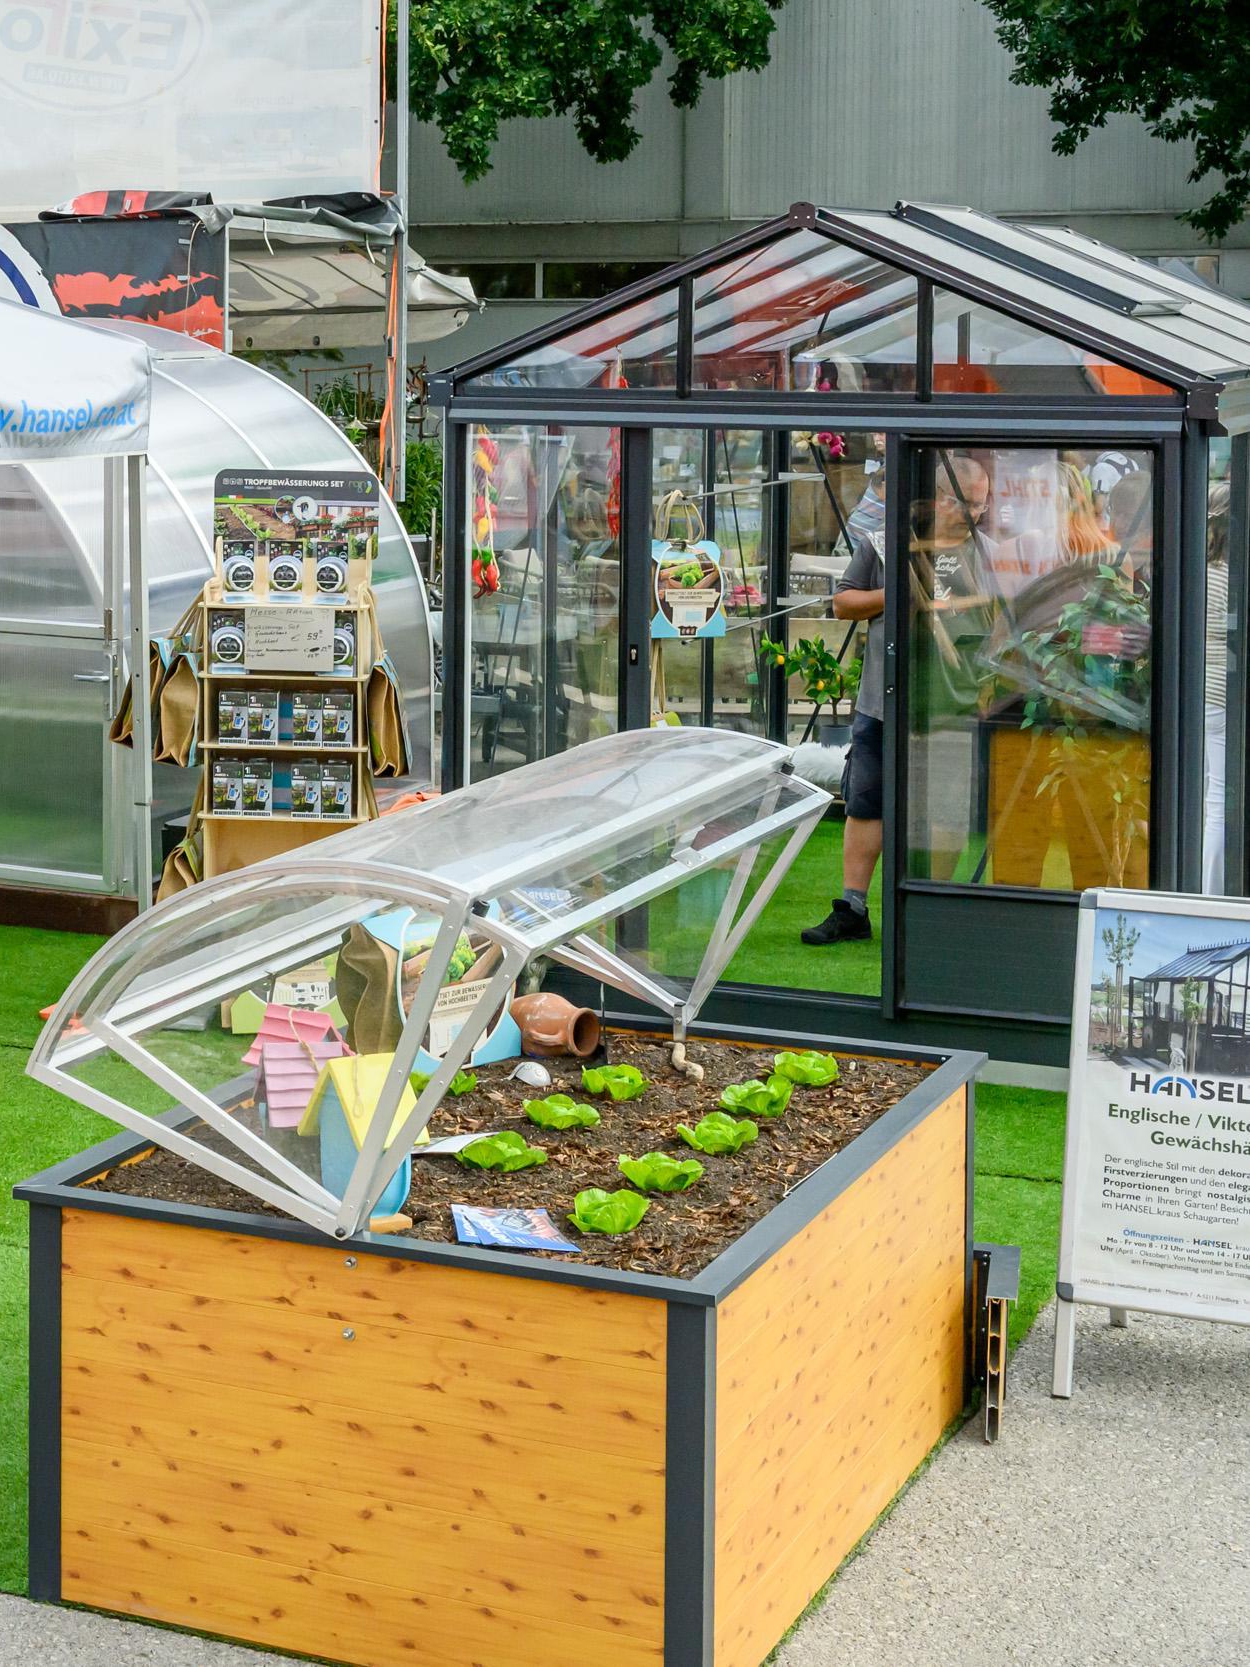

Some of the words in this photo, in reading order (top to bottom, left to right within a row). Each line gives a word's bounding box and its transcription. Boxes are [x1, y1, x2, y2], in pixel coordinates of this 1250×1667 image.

[243, 477, 329, 487] TROPFBEWÄSSERUNGS
[330, 480, 345, 488] SET
[1130, 1072, 1250, 1105] HANSEL
[1108, 1103, 1191, 1127] Englische
[1195, 1113, 1203, 1129] /
[1150, 1130, 1250, 1155] Gewächshä
[1104, 1154, 1121, 1164] Der
[1124, 1158, 1164, 1169] englische
[1166, 1161, 1179, 1170] Stil
[1181, 1164, 1196, 1174] mit
[1198, 1166, 1216, 1175] den
[1103, 1165, 1188, 1184] Firstverzierungen
[1190, 1177, 1207, 1186] und
[1208, 1179, 1226, 1188] den
[1103, 1177, 1170, 1193] Proportionen
[1174, 1186, 1202, 1198] bringt
[1102, 1189, 1142, 1201] Charme
[1145, 1195, 1153, 1203] in
[1157, 1195, 1180, 1206] Ihren
[1184, 1199, 1218, 1211] Garten!
[1220, 1203, 1250, 1215] Besich
[1101, 1201, 1113, 1209] im
[1183, 1210, 1239, 1226] Schaugarten!
[1106, 1236, 1118, 1244] Mo
[1134, 1241, 1147, 1249] von
[1170, 1245, 1184, 1253] Uhr
[1186, 1247, 1200, 1255] und
[1123, 1228, 1184, 1244] Öffnungszeiten
[1193, 1237, 1232, 1250] HANSEL
[1100, 1244, 1114, 1253] Uhr
[1173, 1254, 1186, 1263] Von
